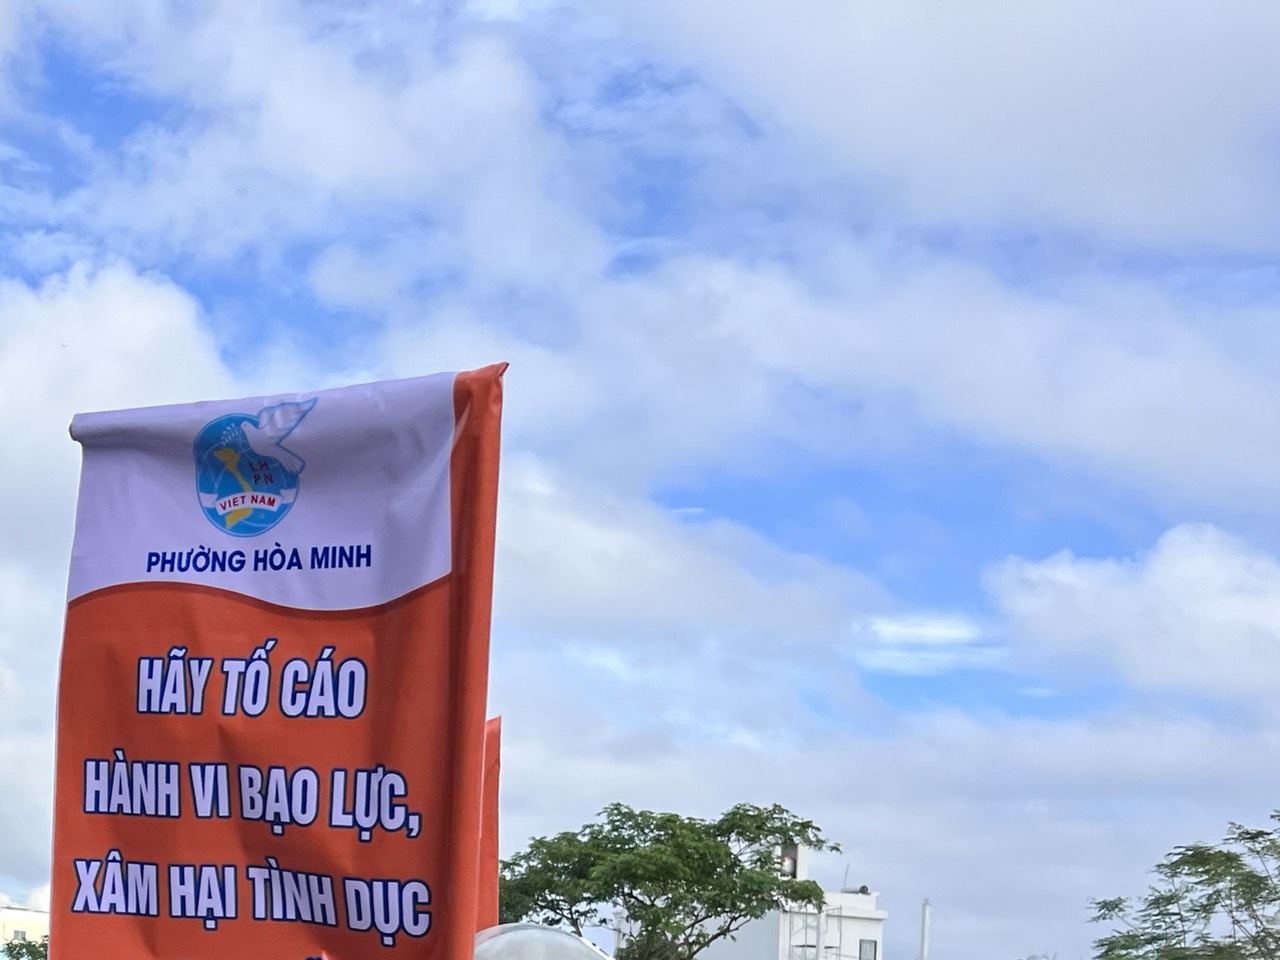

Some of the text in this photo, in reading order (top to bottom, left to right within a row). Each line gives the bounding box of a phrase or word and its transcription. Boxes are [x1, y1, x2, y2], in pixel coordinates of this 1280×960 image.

[219, 494, 276, 511] VIET NAM
[146, 542, 372, 573] PHƯỜNG HÒA MINH
[137, 638, 368, 719] HÃY TỐ CÁO
[84, 750, 421, 842] HÀNH VI BẠO LỰC,
[72, 849, 432, 946] XÂM HẠI TÌNH DỤC
